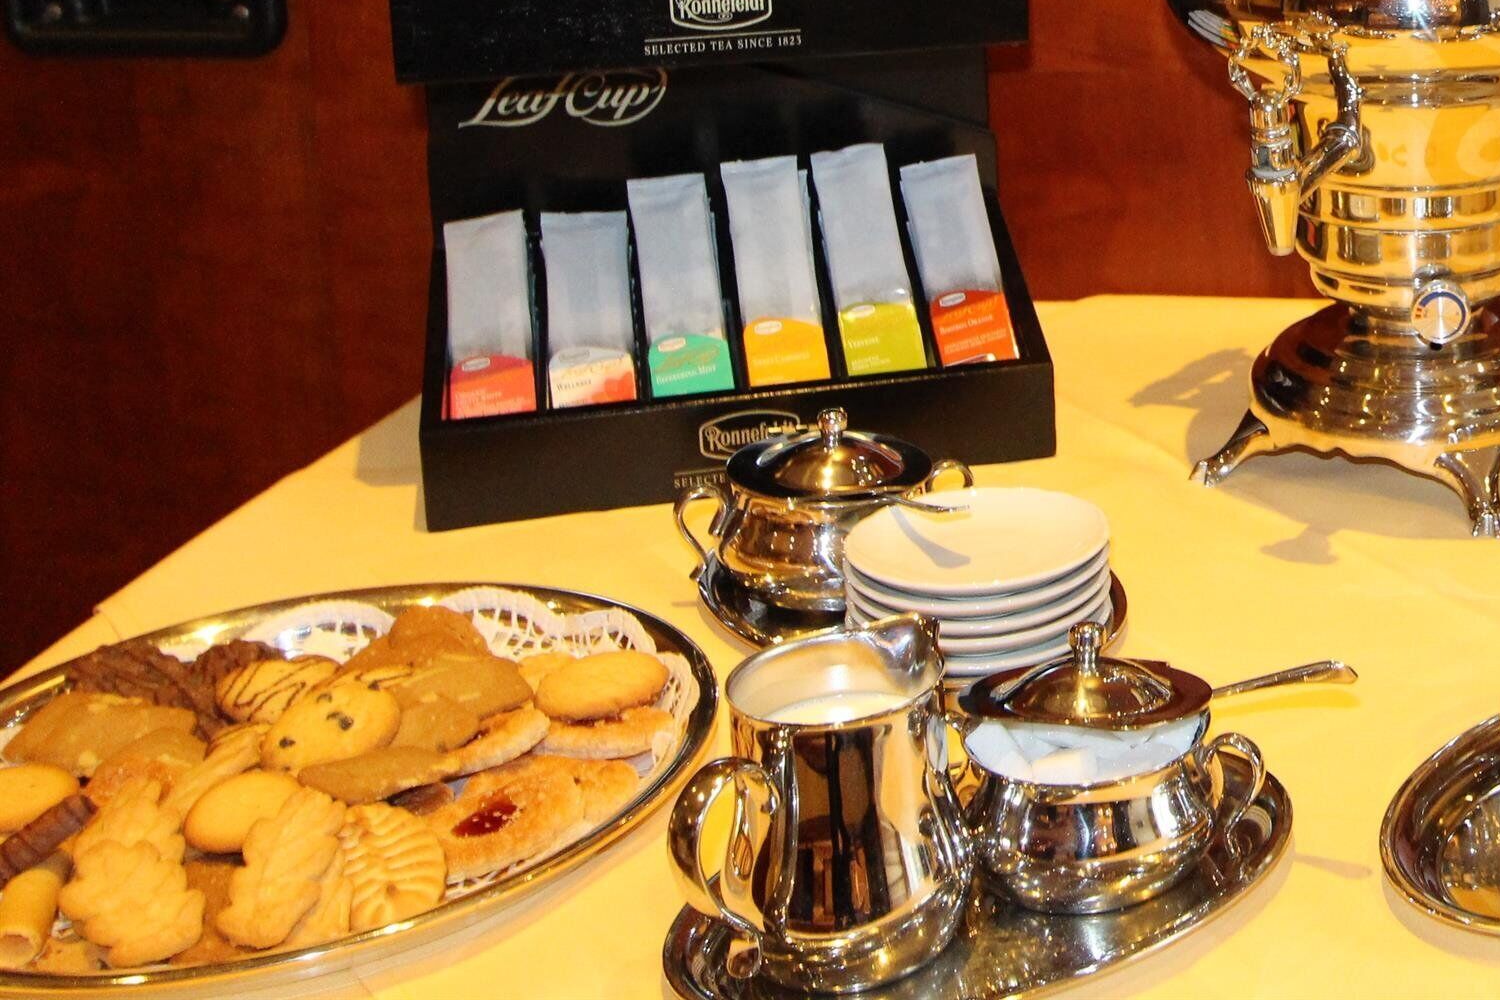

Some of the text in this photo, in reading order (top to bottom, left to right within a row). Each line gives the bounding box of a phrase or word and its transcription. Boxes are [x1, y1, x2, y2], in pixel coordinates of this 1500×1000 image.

[644, 34, 802, 56] SELECTED TEA SINCE 1823
